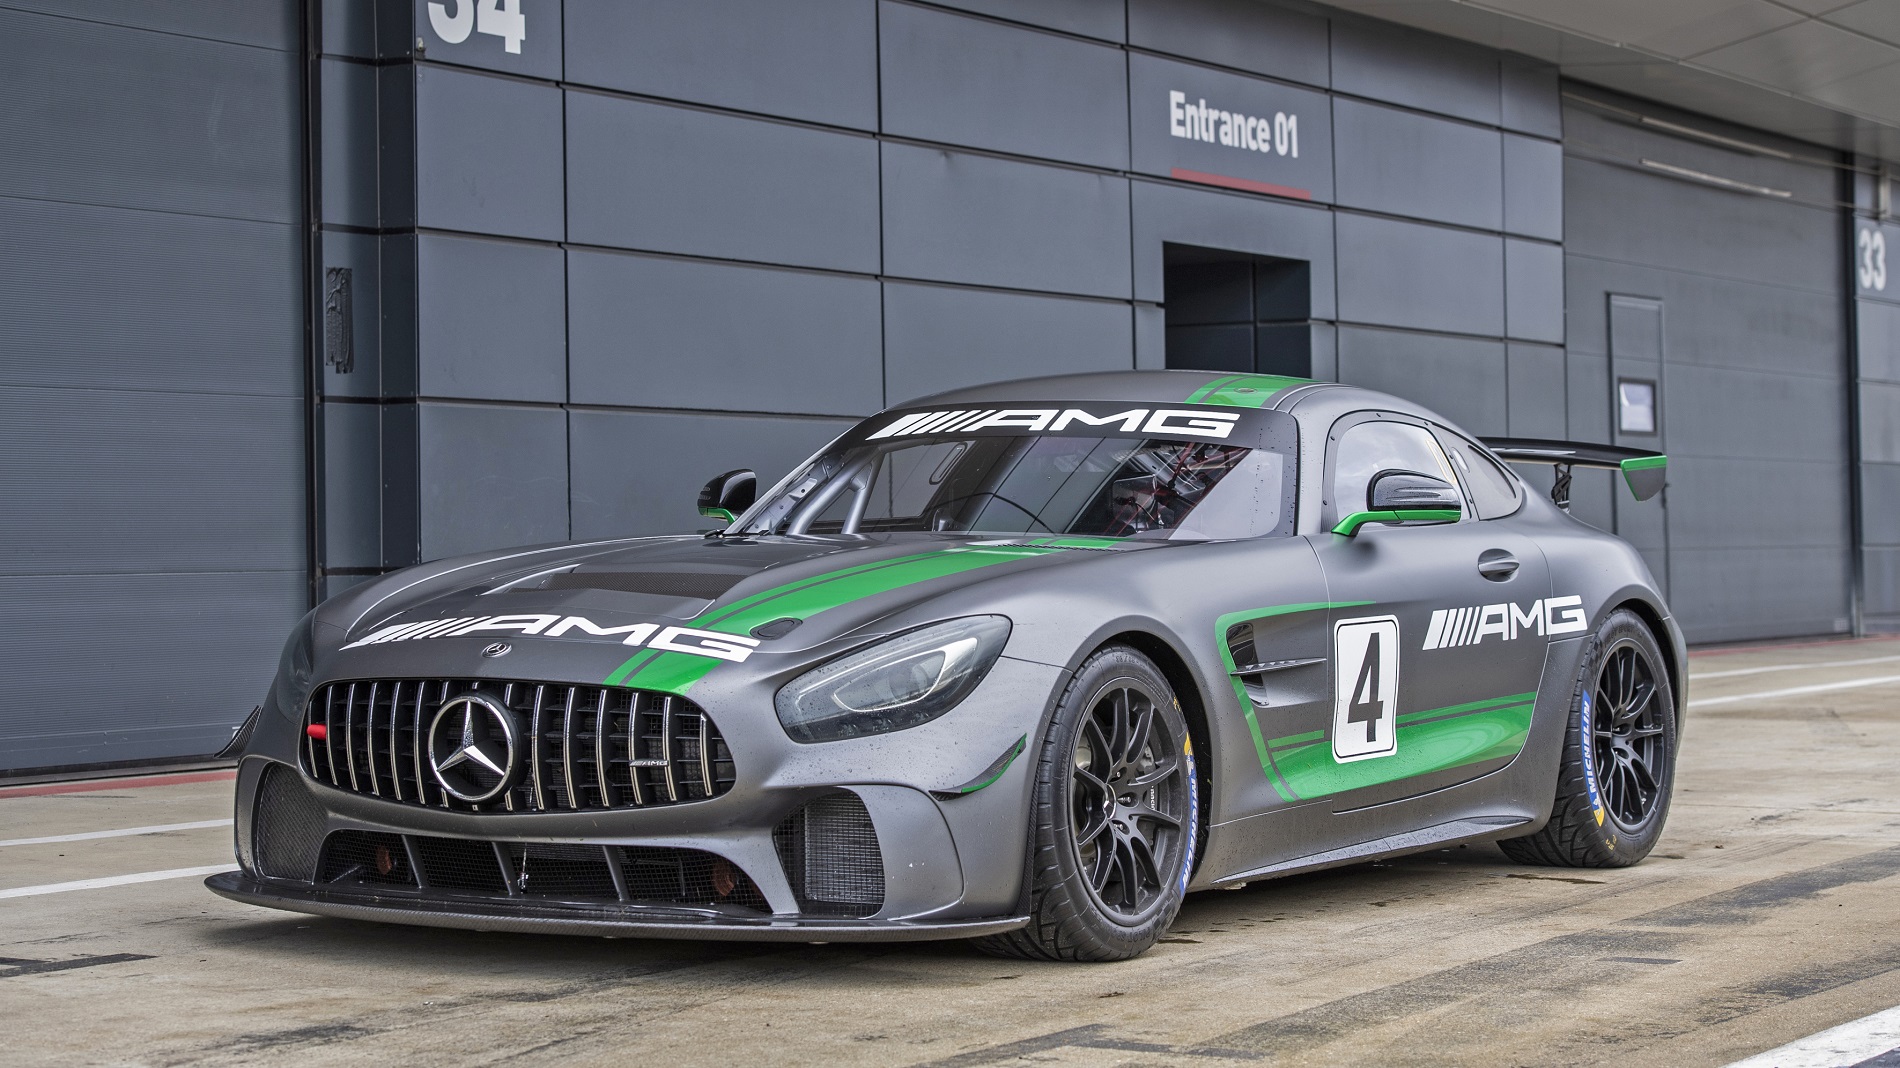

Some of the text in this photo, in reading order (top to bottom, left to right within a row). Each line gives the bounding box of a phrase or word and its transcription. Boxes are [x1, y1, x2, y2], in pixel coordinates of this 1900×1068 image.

[1169, 90, 1299, 158] Entrance 01
[1859, 228, 1887, 291] 33
[960, 409, 1240, 438] AMG
[446, 614, 761, 663] AMG
[1473, 595, 1588, 645] AMG
[1347, 631, 1384, 743] 4
[1583, 700, 1597, 794] MICHELIN
[1183, 778, 1198, 889] MICHELIN
